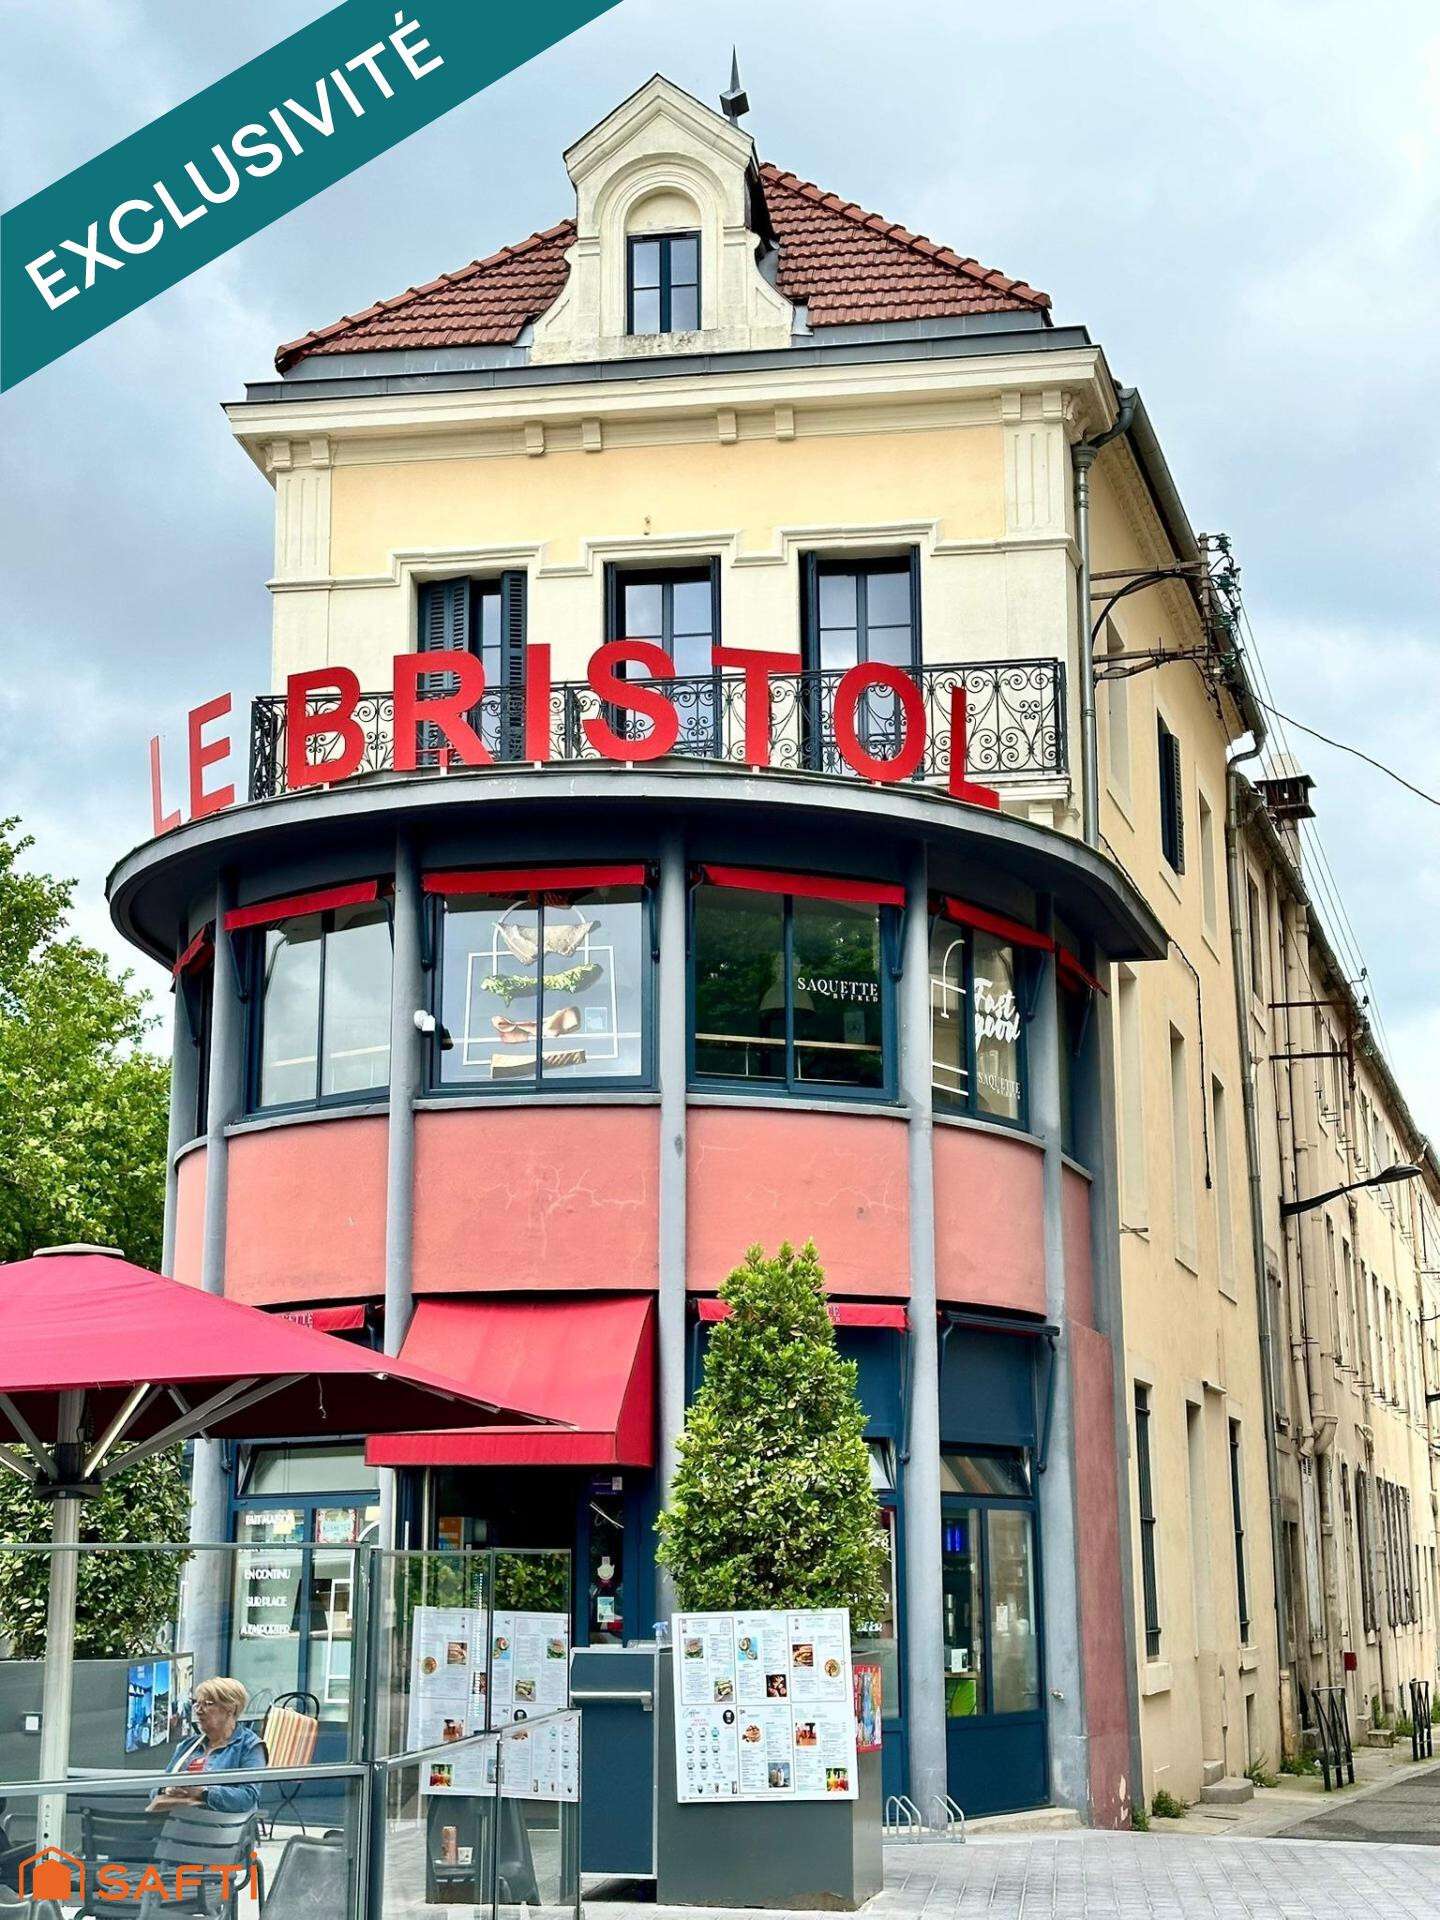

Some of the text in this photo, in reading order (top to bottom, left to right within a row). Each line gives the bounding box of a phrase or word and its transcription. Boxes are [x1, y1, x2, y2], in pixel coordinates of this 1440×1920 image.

[150, 638, 1000, 836] LE BRISTOL
[797, 977, 879, 996] SAQUETTE
